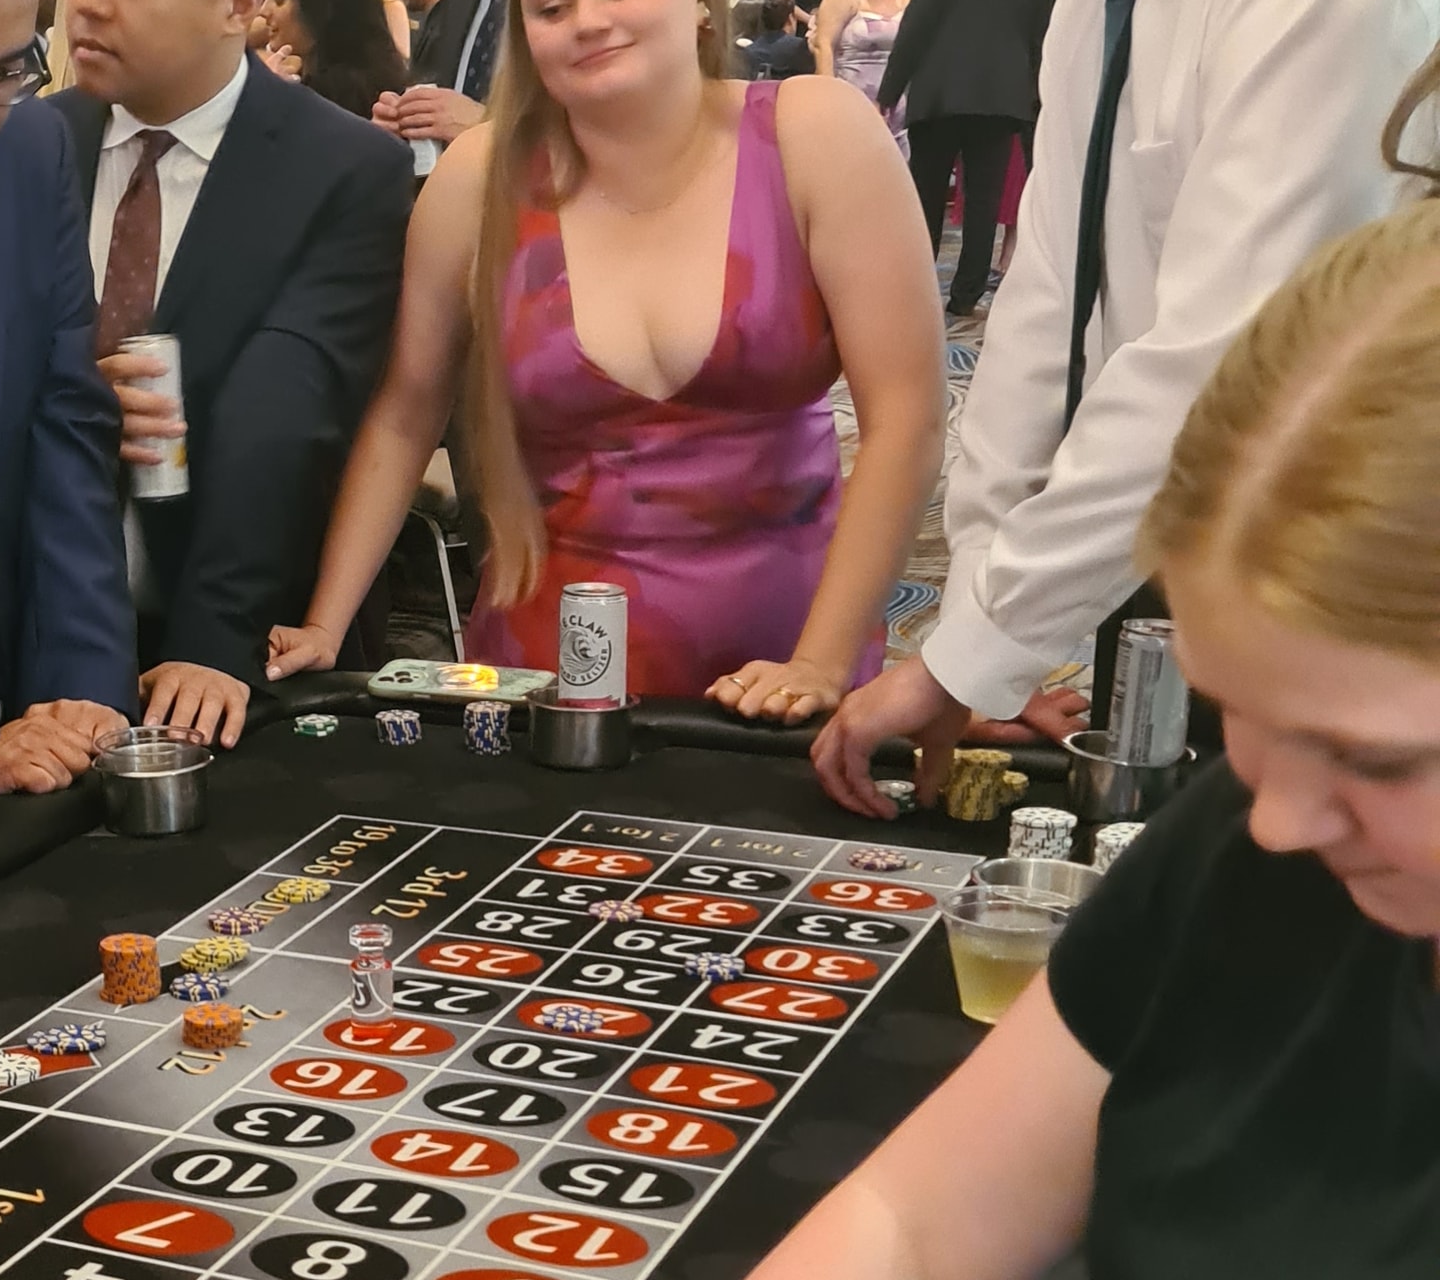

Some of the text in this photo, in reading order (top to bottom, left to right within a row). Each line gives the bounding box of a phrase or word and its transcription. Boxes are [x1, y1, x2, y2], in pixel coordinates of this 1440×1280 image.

[568, 614, 608, 639] CLAW
[581, 648, 608, 682] SELTZER
[579, 822, 681, 843] 2 for 1
[708, 837, 813, 859] 2 for 1
[303, 823, 397, 877] 19 to 36
[552, 849, 644, 874] 34
[370, 866, 469, 919] 3rd 12
[516, 878, 607, 906] 31
[683, 865, 777, 891] 35
[659, 895, 749, 925] 32
[824, 882, 924, 910] 36
[475, 910, 572, 940] 28
[796, 914, 897, 944] 33
[429, 944, 530, 975] 25
[613, 928, 712, 960] 29
[572, 963, 678, 996] 26
[762, 948, 867, 981] 30
[393, 979, 490, 1013] 22
[722, 986, 834, 1019] 27
[690, 1023, 801, 1061] 24
[160, 1049, 228, 1075] 12
[487, 1042, 598, 1079] 20
[283, 1061, 379, 1097] 16
[647, 1065, 759, 1105] 21
[437, 1087, 539, 1123] 17
[232, 1106, 327, 1144] 13
[607, 1112, 711, 1152] 18
[390, 1132, 492, 1173] 14
[171, 1153, 270, 1194] 10
[557, 1163, 665, 1205] 15
[334, 1181, 433, 1224] 11
[112, 1210, 197, 1250] 7
[511, 1213, 620, 1261] 12
